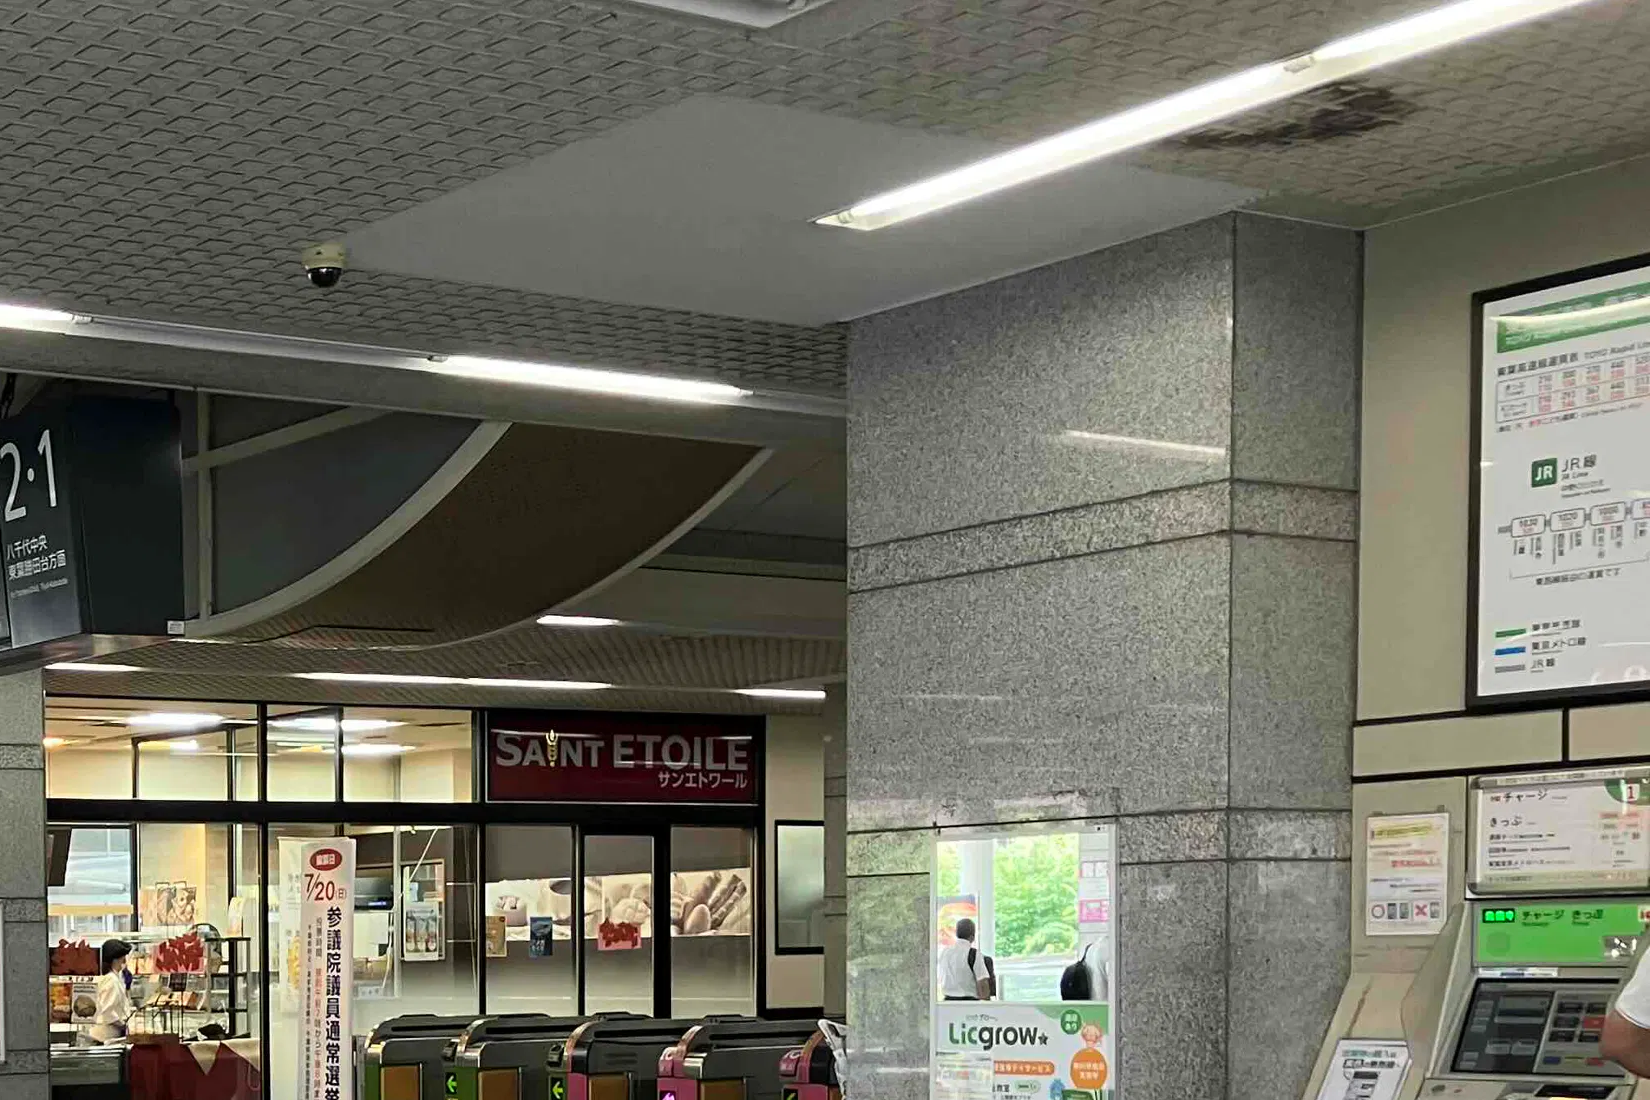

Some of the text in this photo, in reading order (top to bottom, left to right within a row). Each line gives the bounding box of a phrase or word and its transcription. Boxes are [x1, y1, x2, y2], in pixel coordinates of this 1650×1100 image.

[1534, 465, 1554, 481] JR
[6, 534, 48, 561] 八千代中央
[612, 734, 749, 771] ETOILE
[657, 771, 748, 789] サンエトワール
[948, 1022, 1038, 1051] Licgrow
